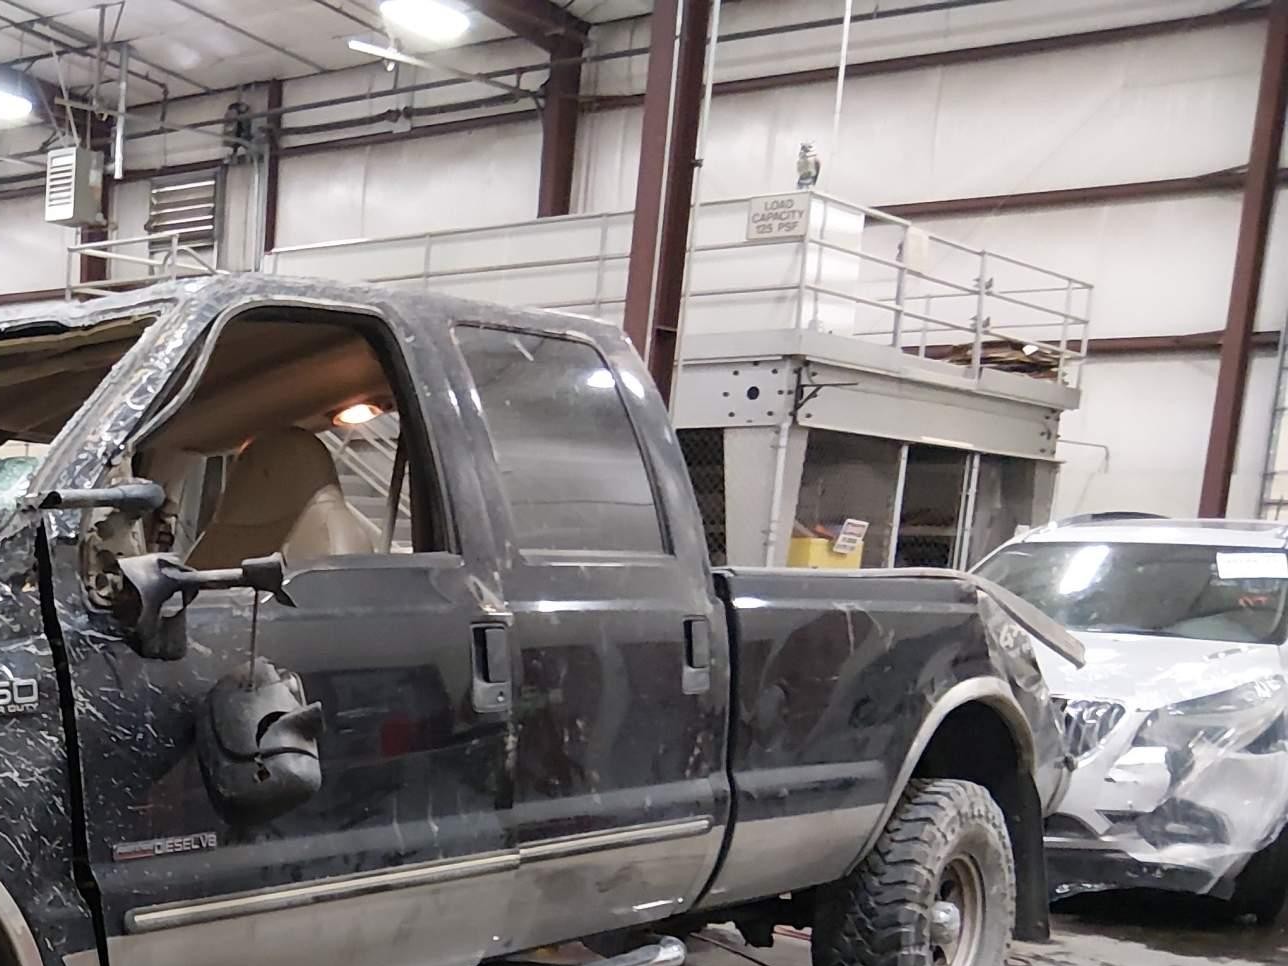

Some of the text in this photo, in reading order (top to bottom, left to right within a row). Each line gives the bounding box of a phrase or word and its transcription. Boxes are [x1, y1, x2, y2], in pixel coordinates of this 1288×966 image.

[764, 199, 794, 211] LOAD
[752, 209, 804, 223] CAPACITY
[755, 220, 799, 234] 125 PSF
[7, 702, 40, 713] DUTY
[154, 835, 200, 855] DESEL
